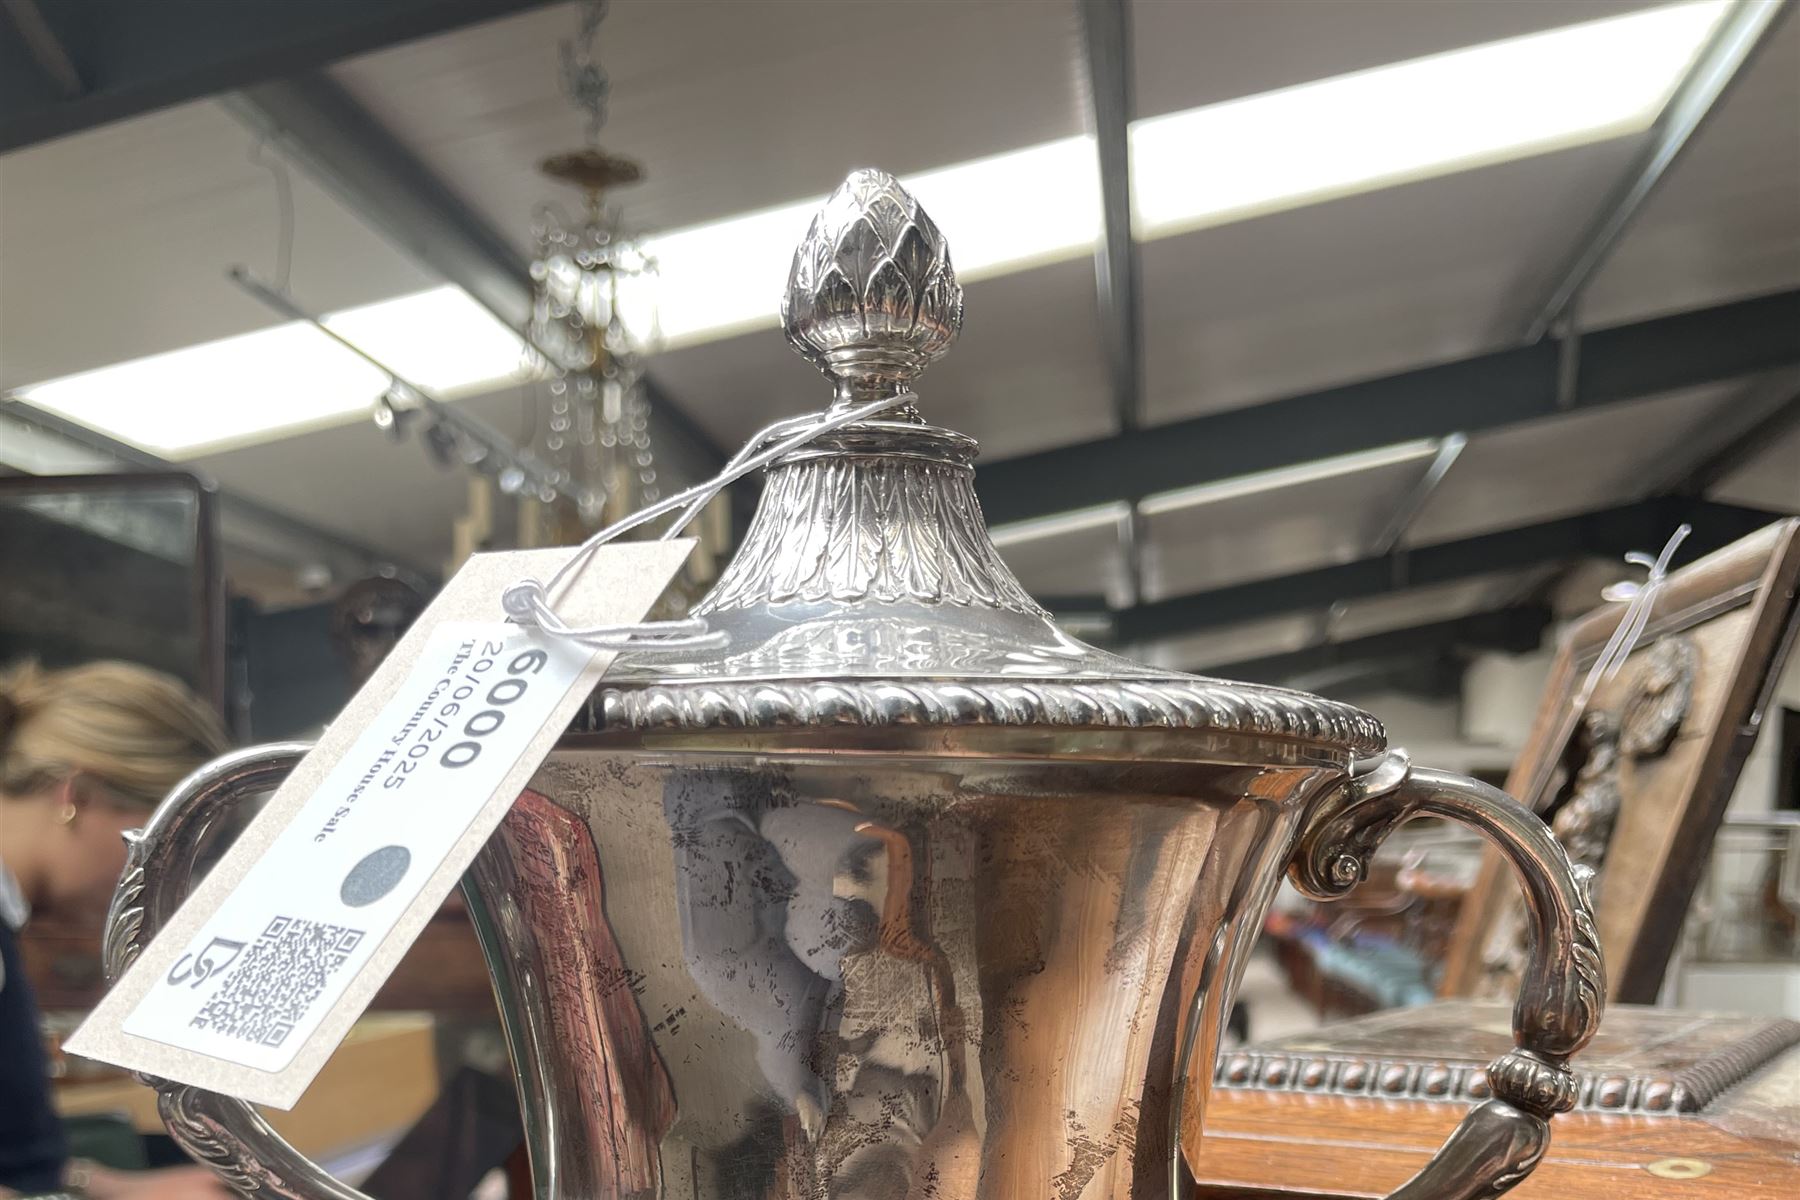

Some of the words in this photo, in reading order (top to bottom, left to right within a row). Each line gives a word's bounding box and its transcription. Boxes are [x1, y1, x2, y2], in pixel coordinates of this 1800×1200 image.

[447, 639, 476, 674] The
[383, 641, 504, 789] 20/06/2025
[392, 678, 451, 745] Country
[440, 649, 548, 768] 6000
[346, 749, 397, 802] House
[314, 806, 351, 842] Sale
